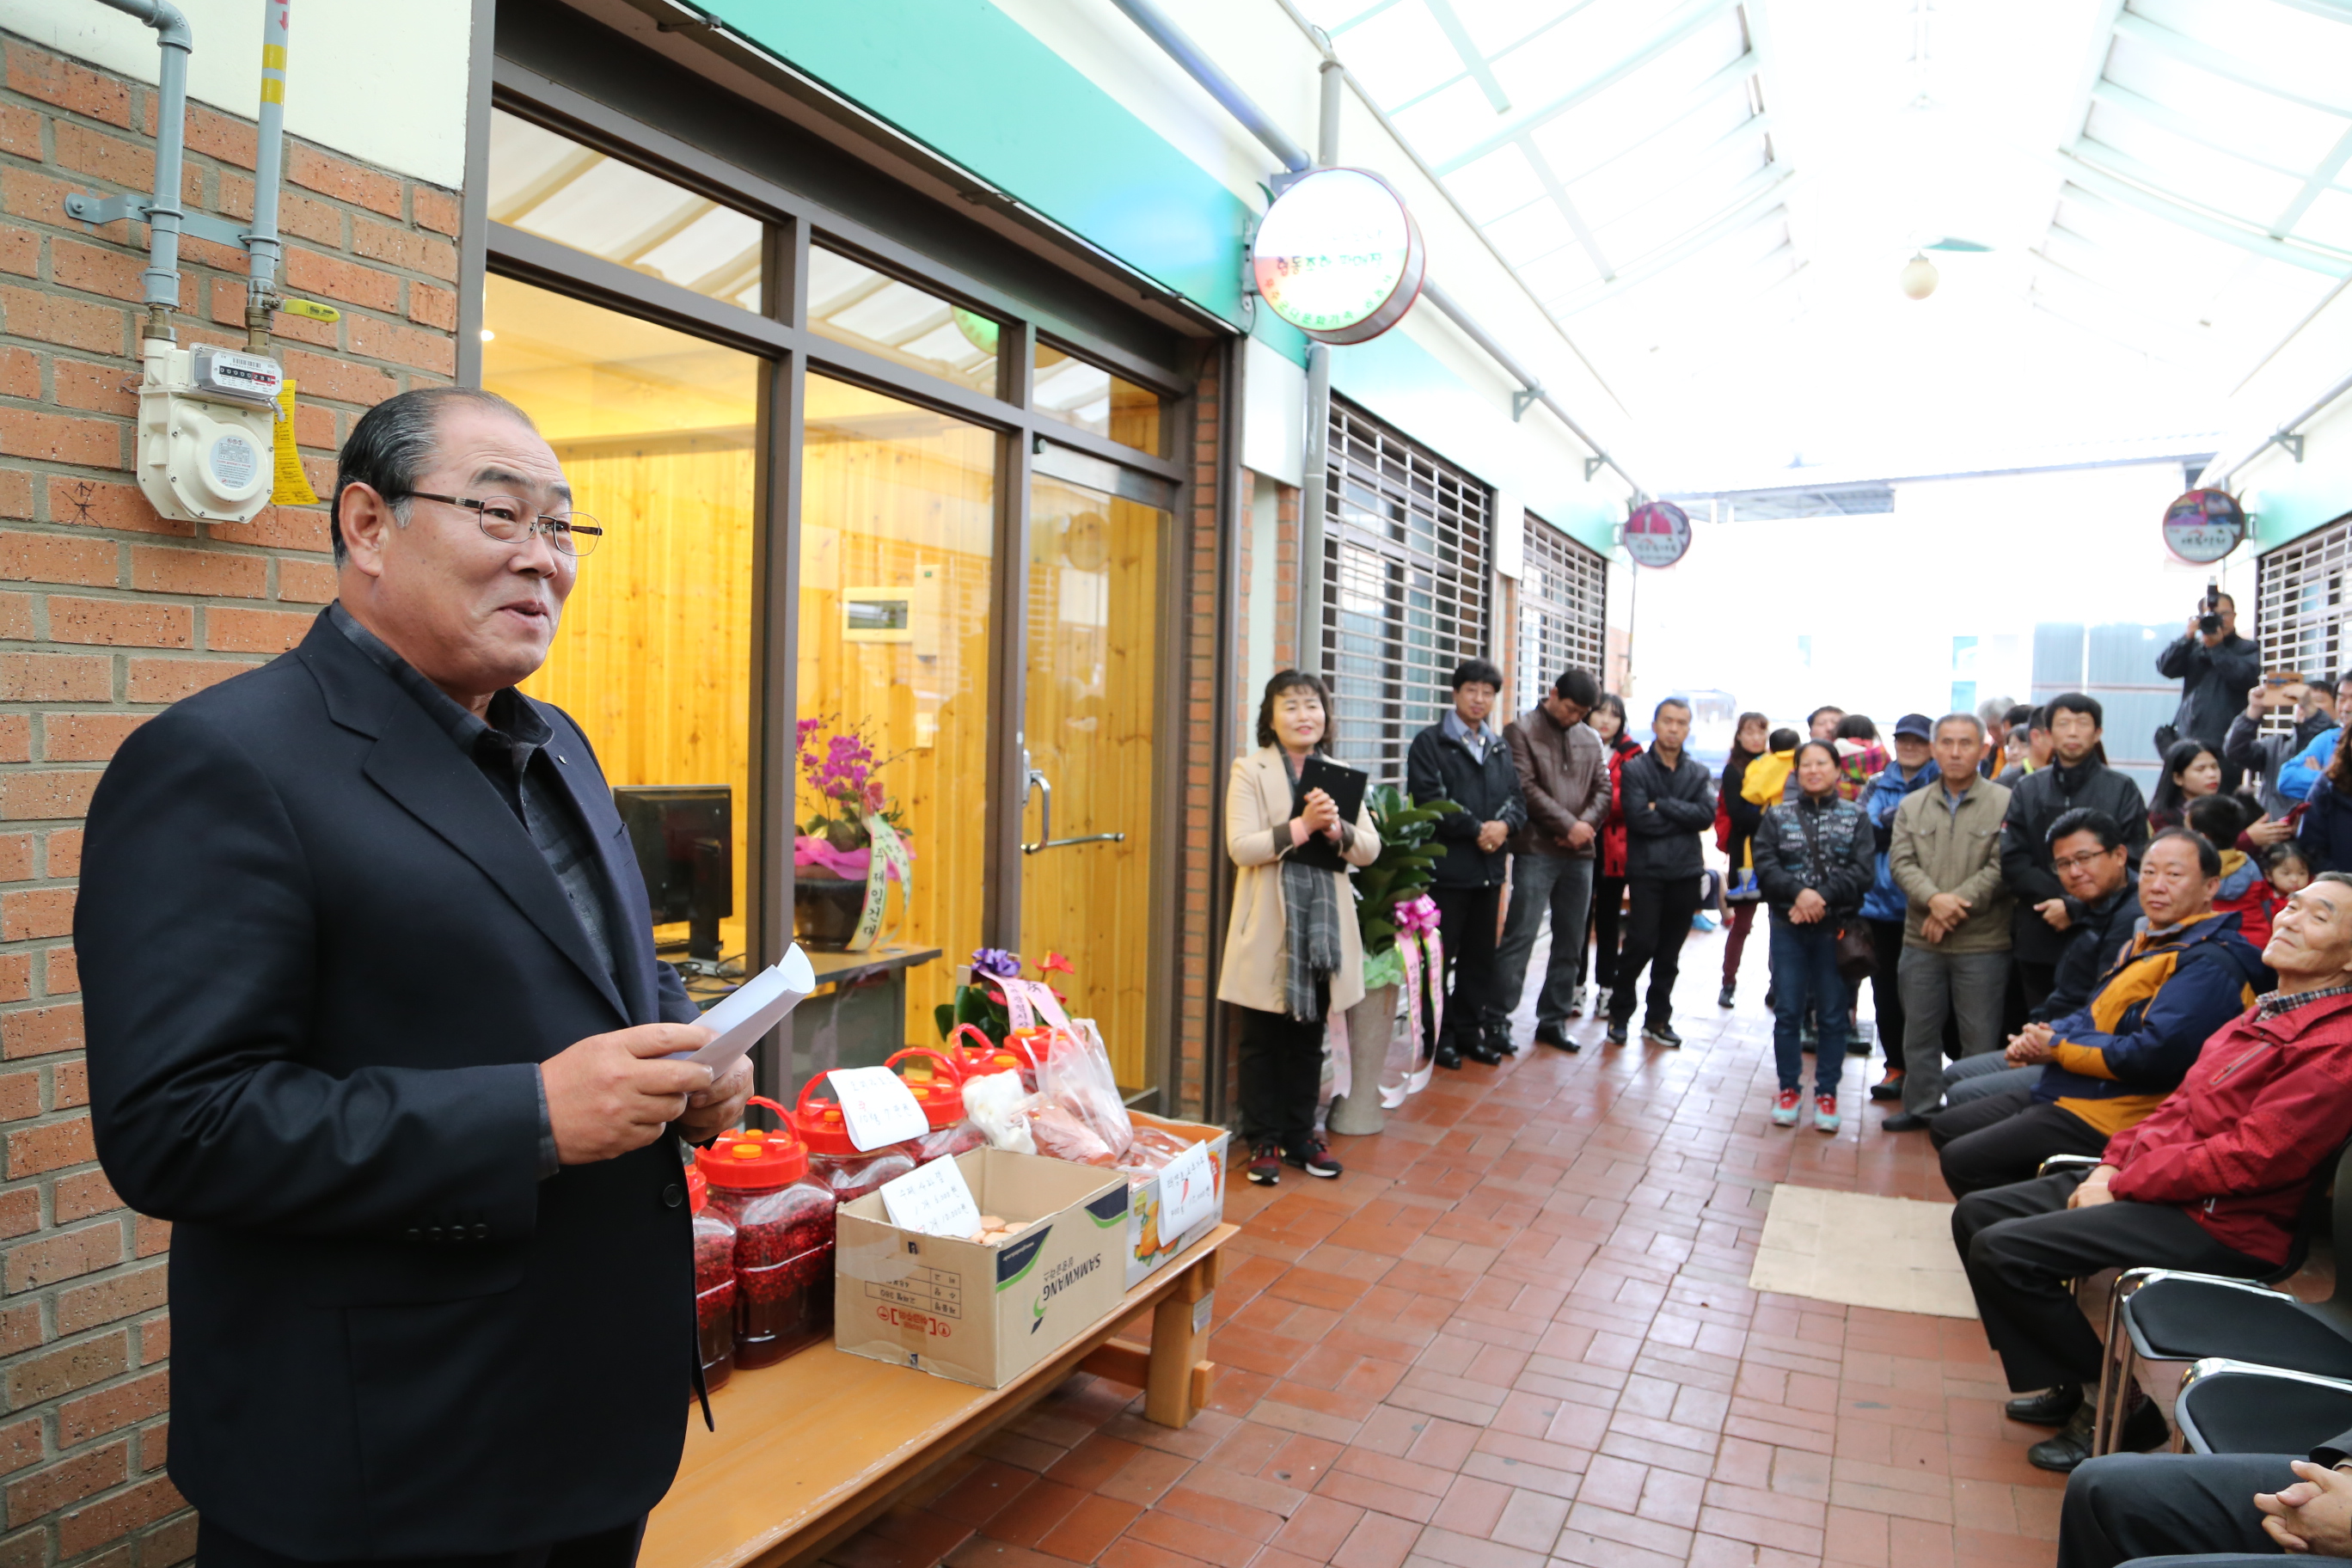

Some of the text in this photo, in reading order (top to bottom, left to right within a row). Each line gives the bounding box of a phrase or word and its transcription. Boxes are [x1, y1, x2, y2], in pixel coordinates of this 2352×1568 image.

[1042, 1253, 1101, 1302] SAMKWANG
[1043, 1256, 1074, 1283] 삼광글라스
[934, 1302, 957, 1315] 제품명
